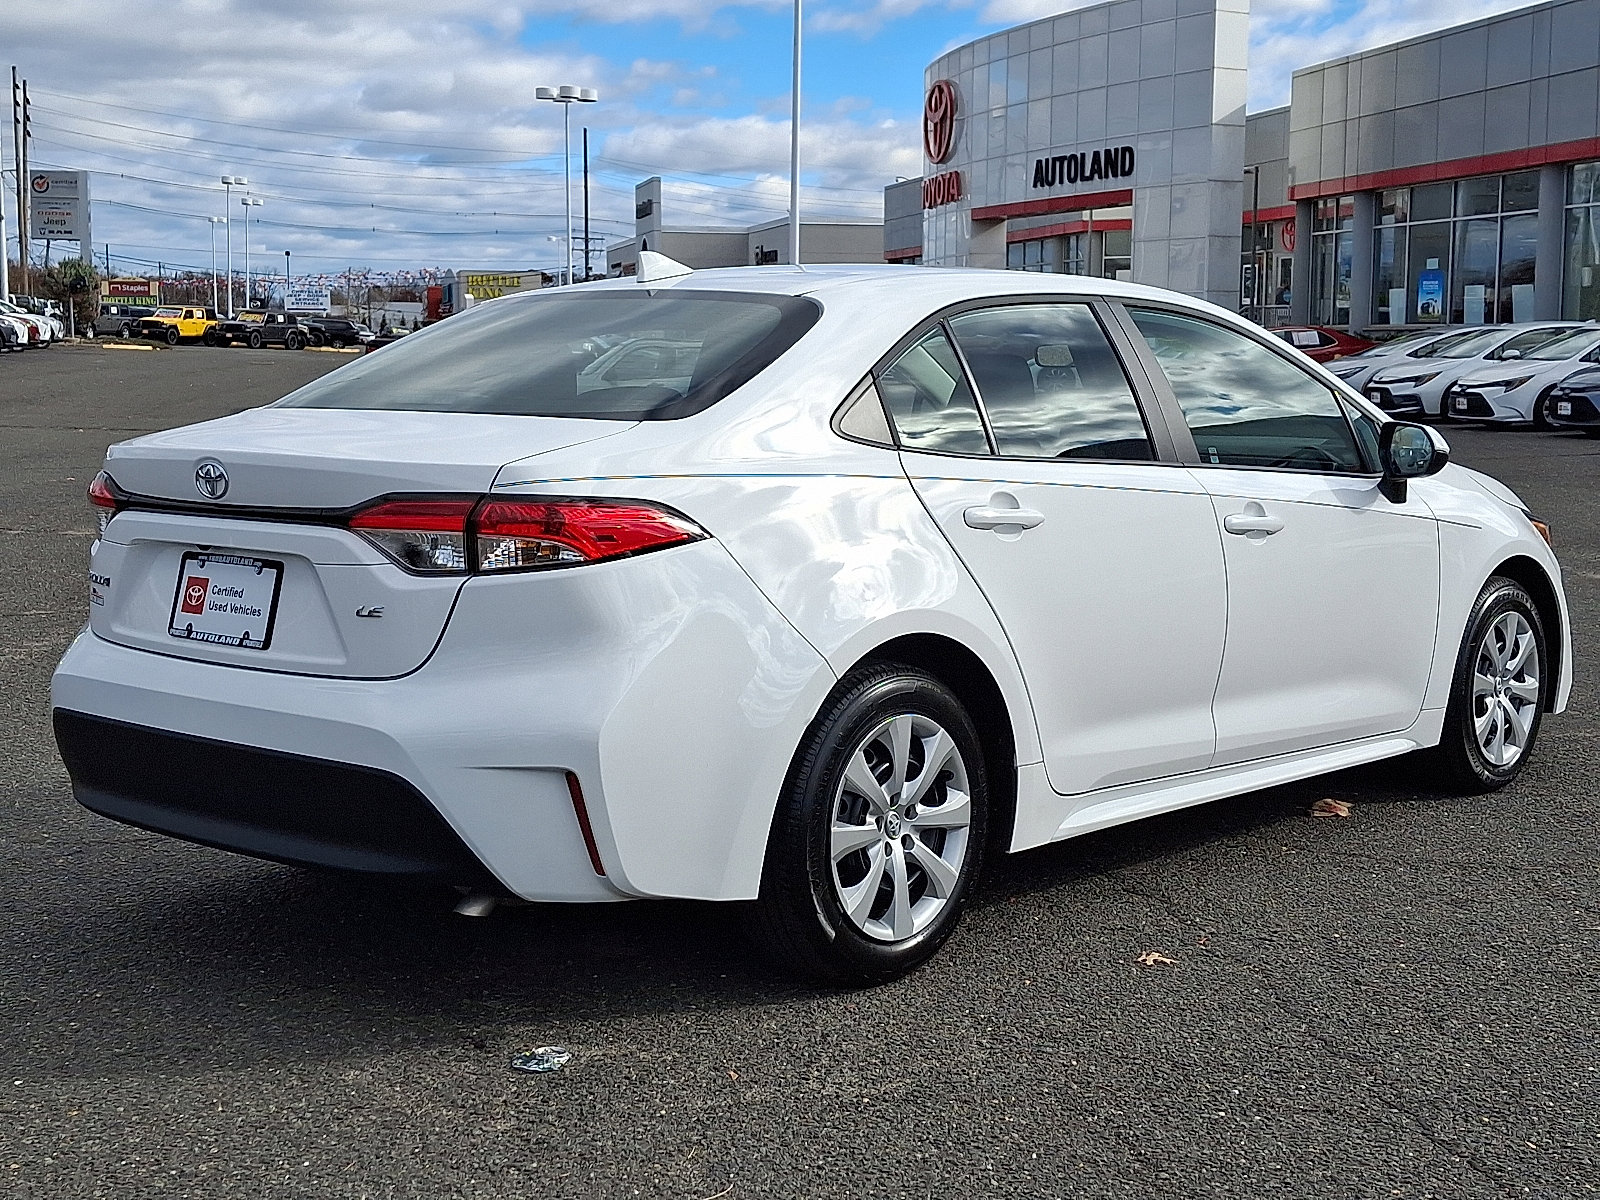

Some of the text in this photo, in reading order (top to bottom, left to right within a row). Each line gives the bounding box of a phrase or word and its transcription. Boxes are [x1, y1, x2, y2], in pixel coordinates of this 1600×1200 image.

[1032, 146, 1135, 188] AUTOLAND
[921, 170, 962, 209] TOYOTA
[43, 216, 67, 227] Jeep
[121, 284, 149, 293] Staples
[103, 296, 135, 305] BOTTLE
[136, 297, 157, 305] KING
[211, 584, 245, 599] Certified
[208, 600, 262, 618] Used Vehicles
[355, 605, 385, 618] LE
[190, 630, 241, 646] AUTOLAND
